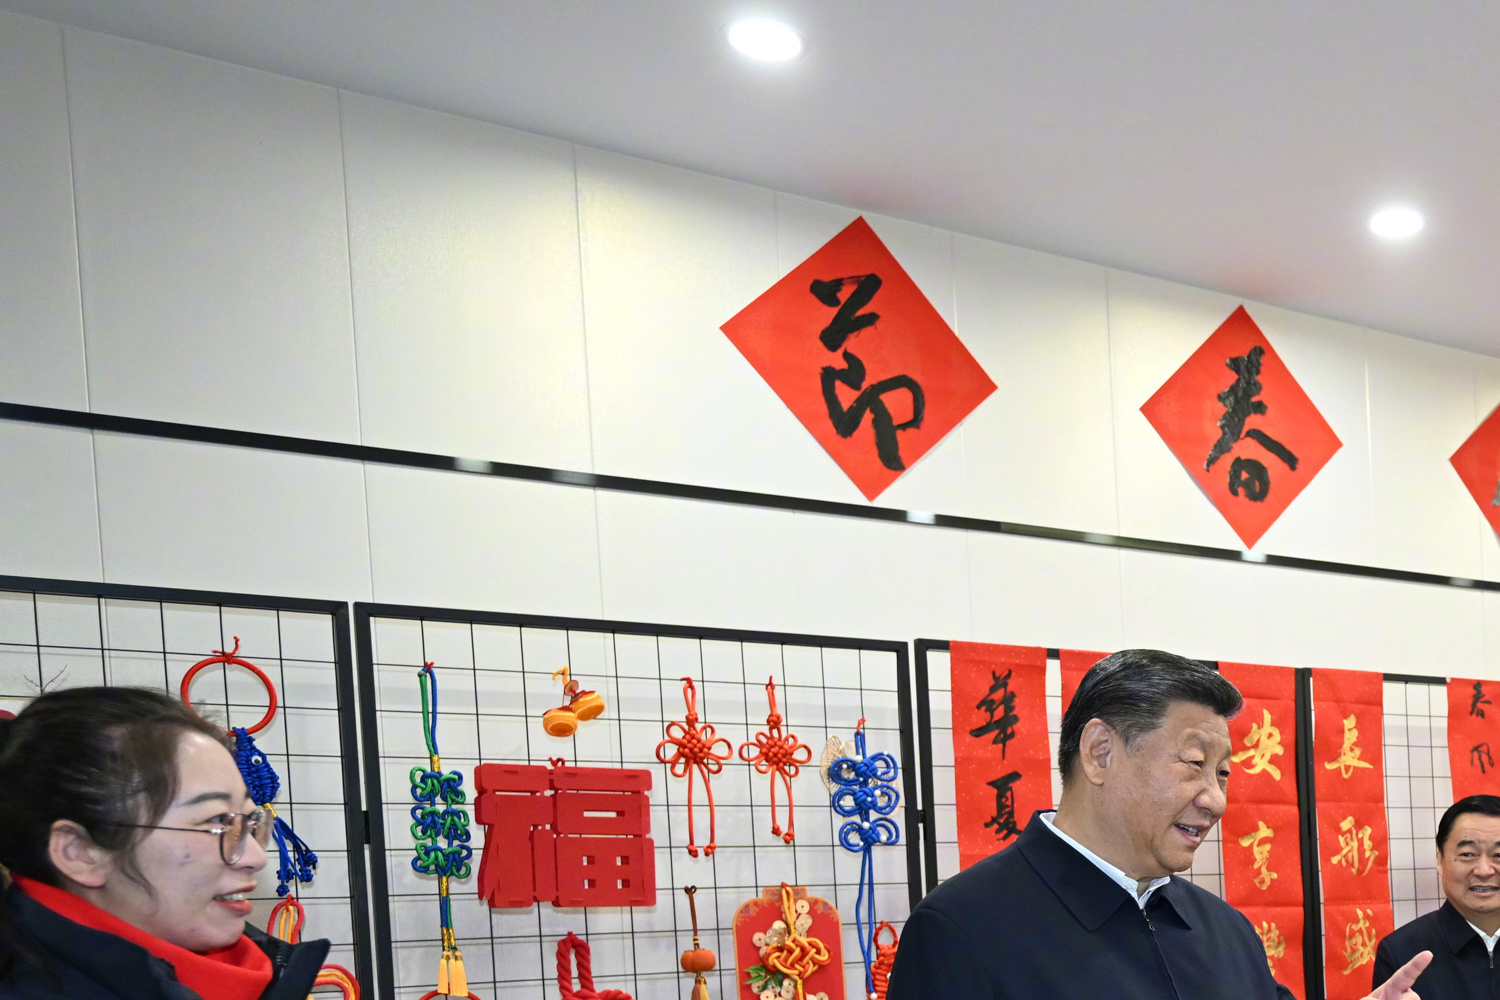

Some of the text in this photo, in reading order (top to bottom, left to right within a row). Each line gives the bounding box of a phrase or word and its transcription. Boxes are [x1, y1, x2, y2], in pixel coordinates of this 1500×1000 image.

[1204, 345, 1299, 502] 春
[969, 669, 1023, 842] 華夏
[474, 763, 657, 907] 福
